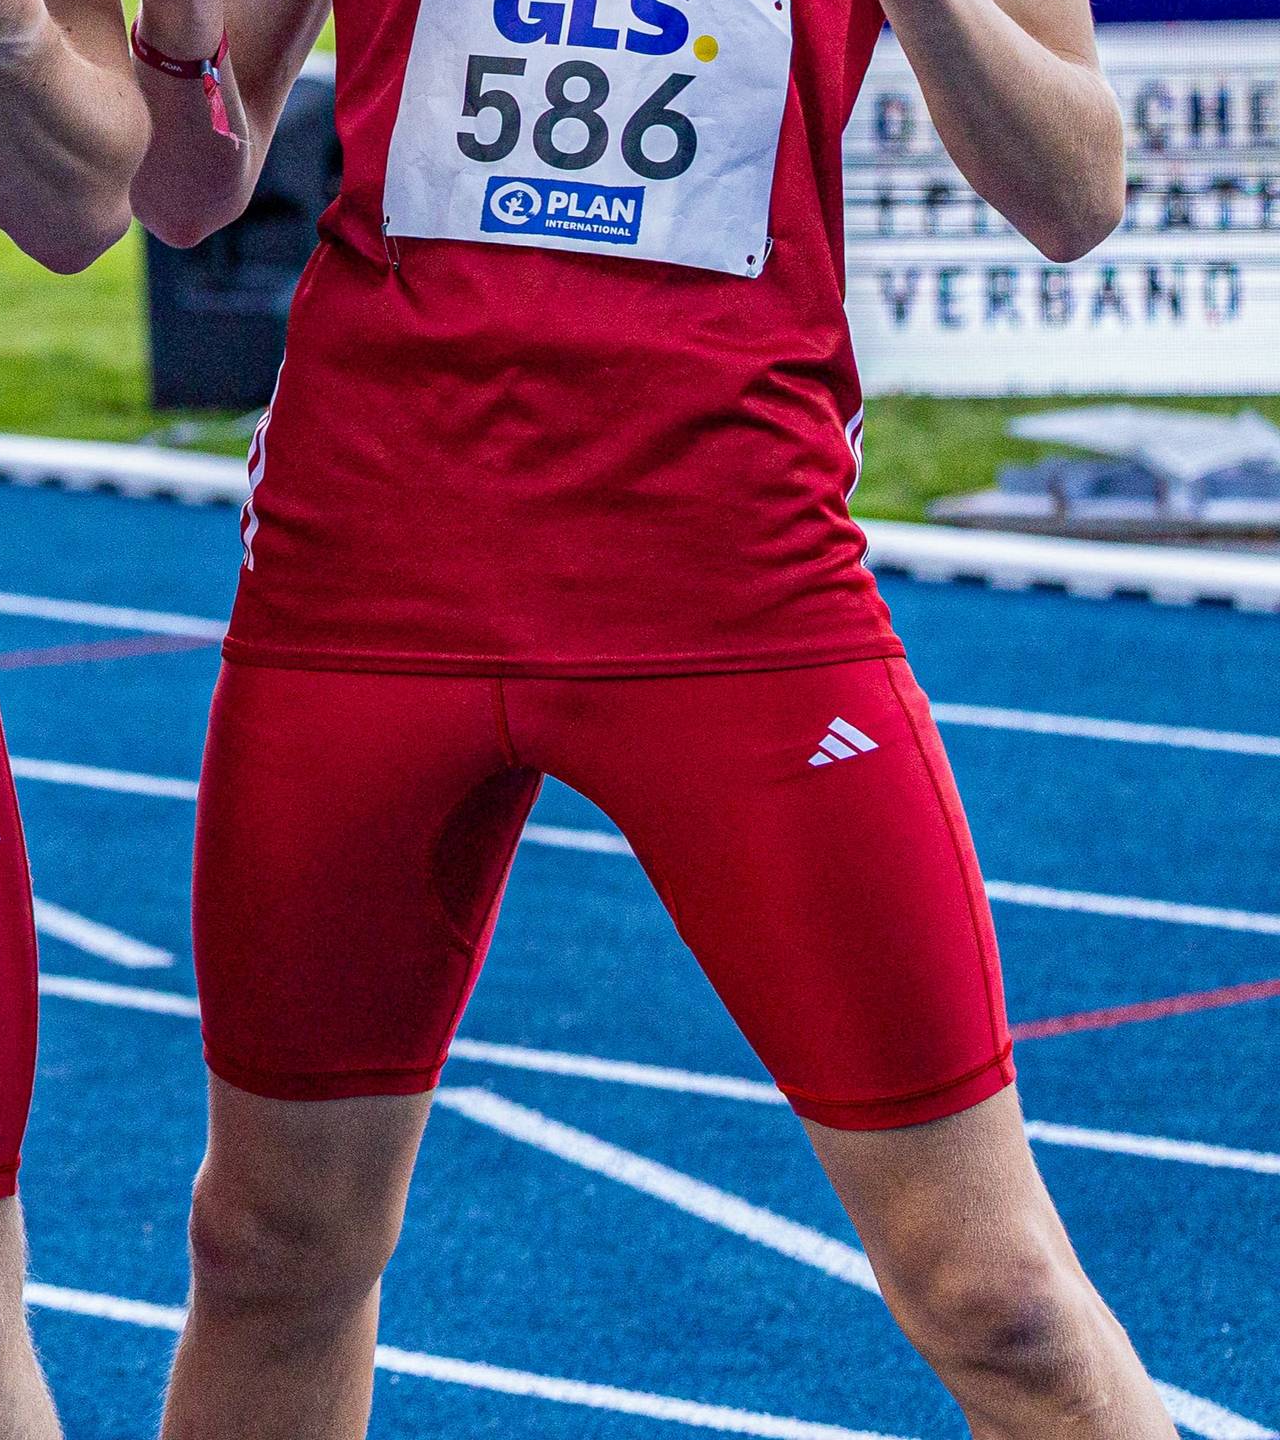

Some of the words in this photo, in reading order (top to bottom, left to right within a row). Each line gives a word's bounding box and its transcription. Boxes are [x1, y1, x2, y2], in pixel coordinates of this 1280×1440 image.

[457, 54, 697, 180] 586
[547, 190, 636, 224] PLAN
[544, 219, 631, 237] INTERNATIONAL
